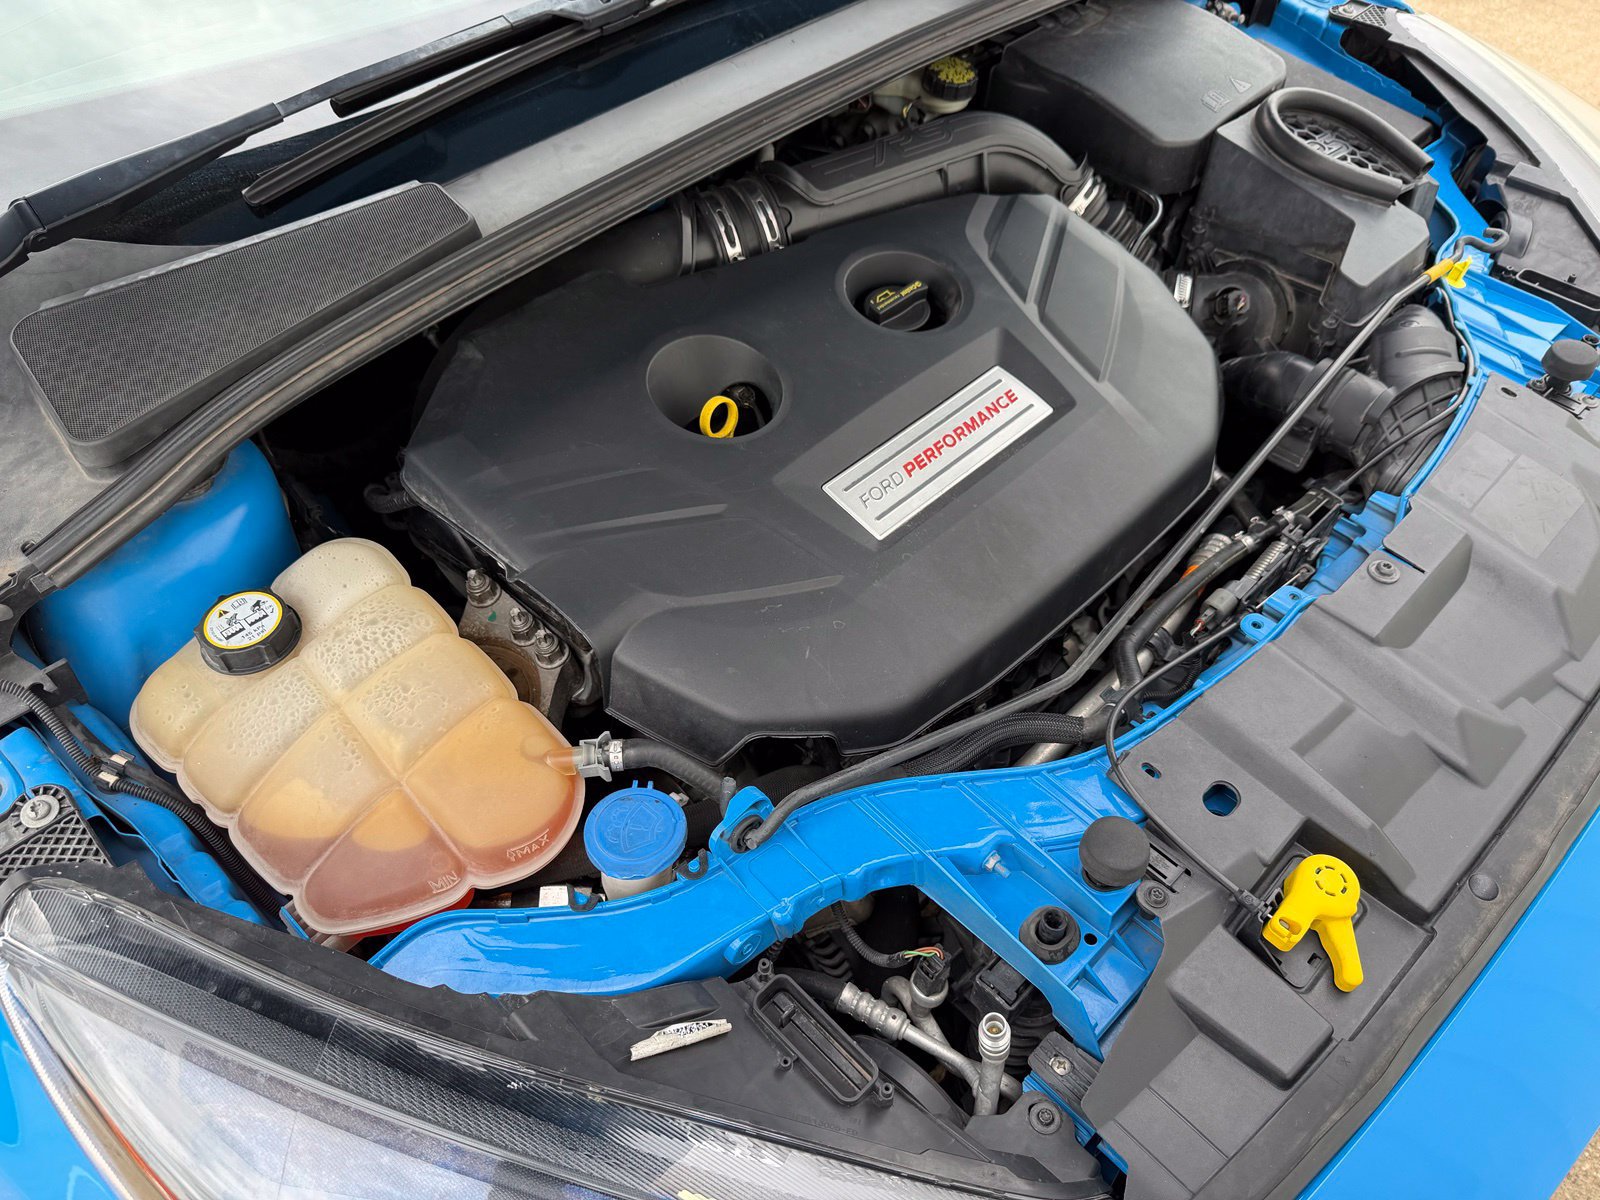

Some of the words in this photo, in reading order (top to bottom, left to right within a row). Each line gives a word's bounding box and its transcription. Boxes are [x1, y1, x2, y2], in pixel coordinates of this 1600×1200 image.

[858, 471, 904, 510] FORD
[903, 389, 1019, 478] PERFORMANCE
[516, 834, 550, 859] MAX
[427, 870, 459, 892] MIN
